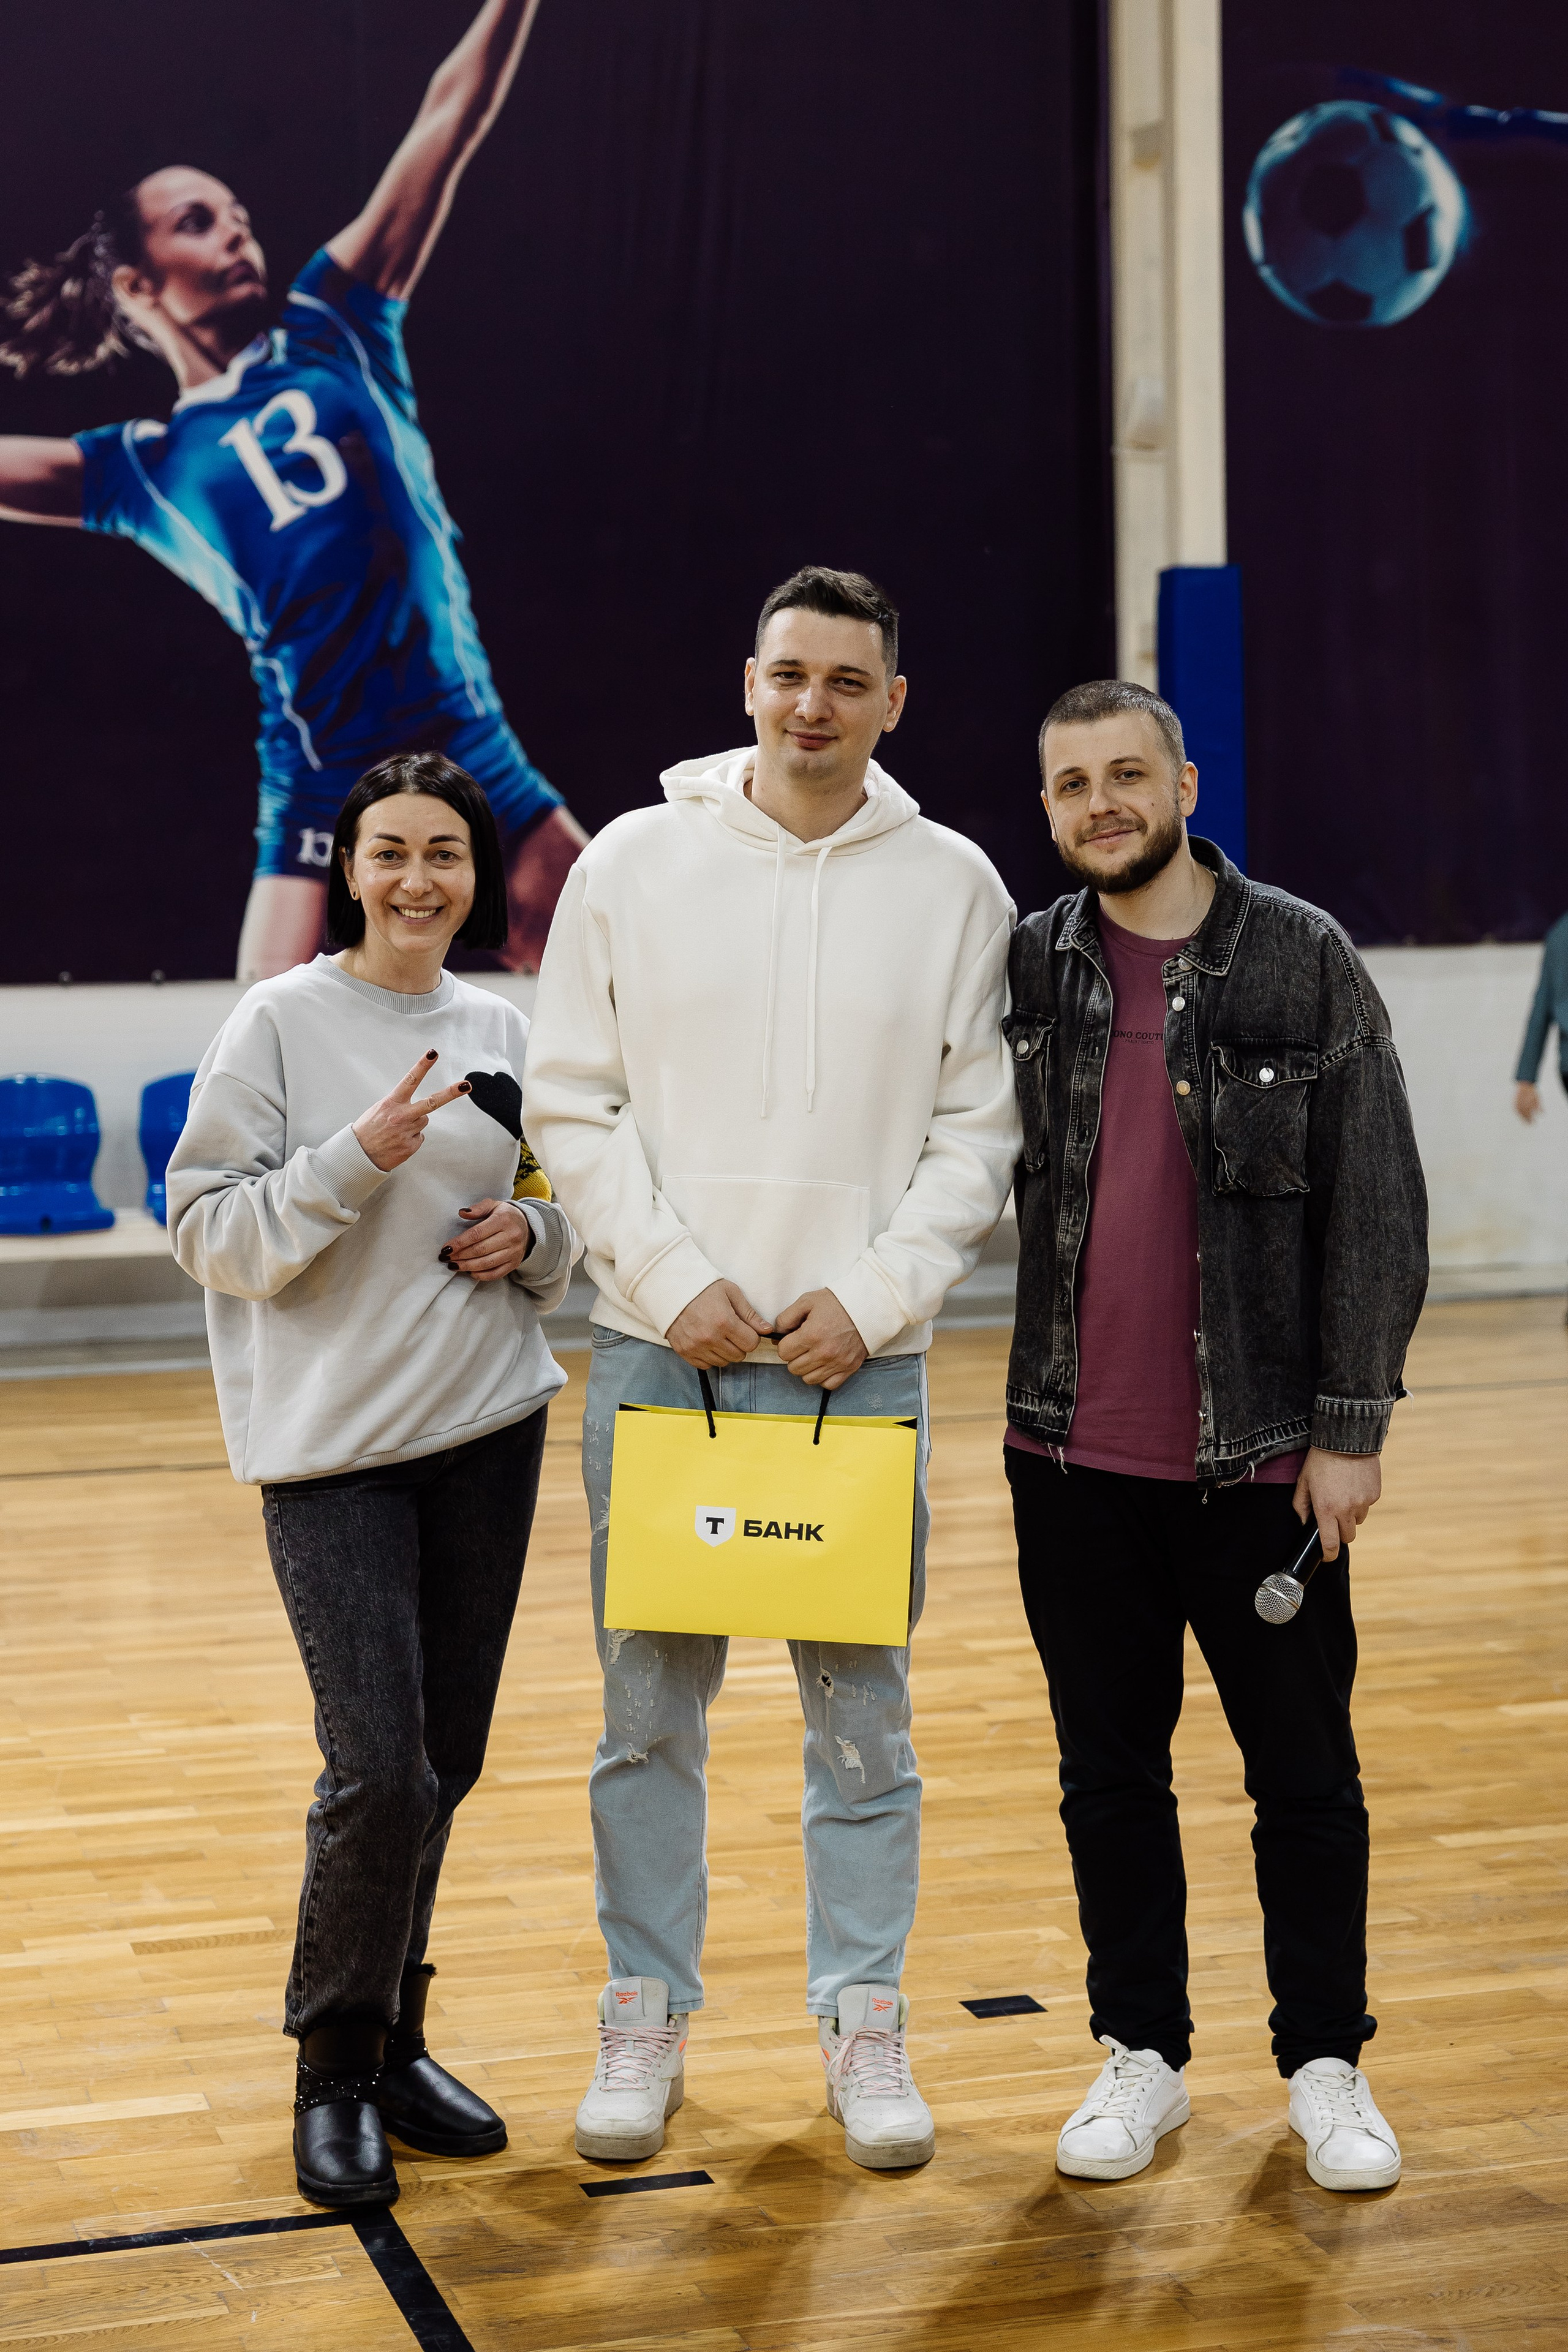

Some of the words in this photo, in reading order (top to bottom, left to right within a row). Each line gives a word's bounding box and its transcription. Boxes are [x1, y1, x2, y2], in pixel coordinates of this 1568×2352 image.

[217, 388, 348, 532] 13
[743, 1519, 825, 1542] БАНК
[872, 1997, 894, 2006] Reebok
